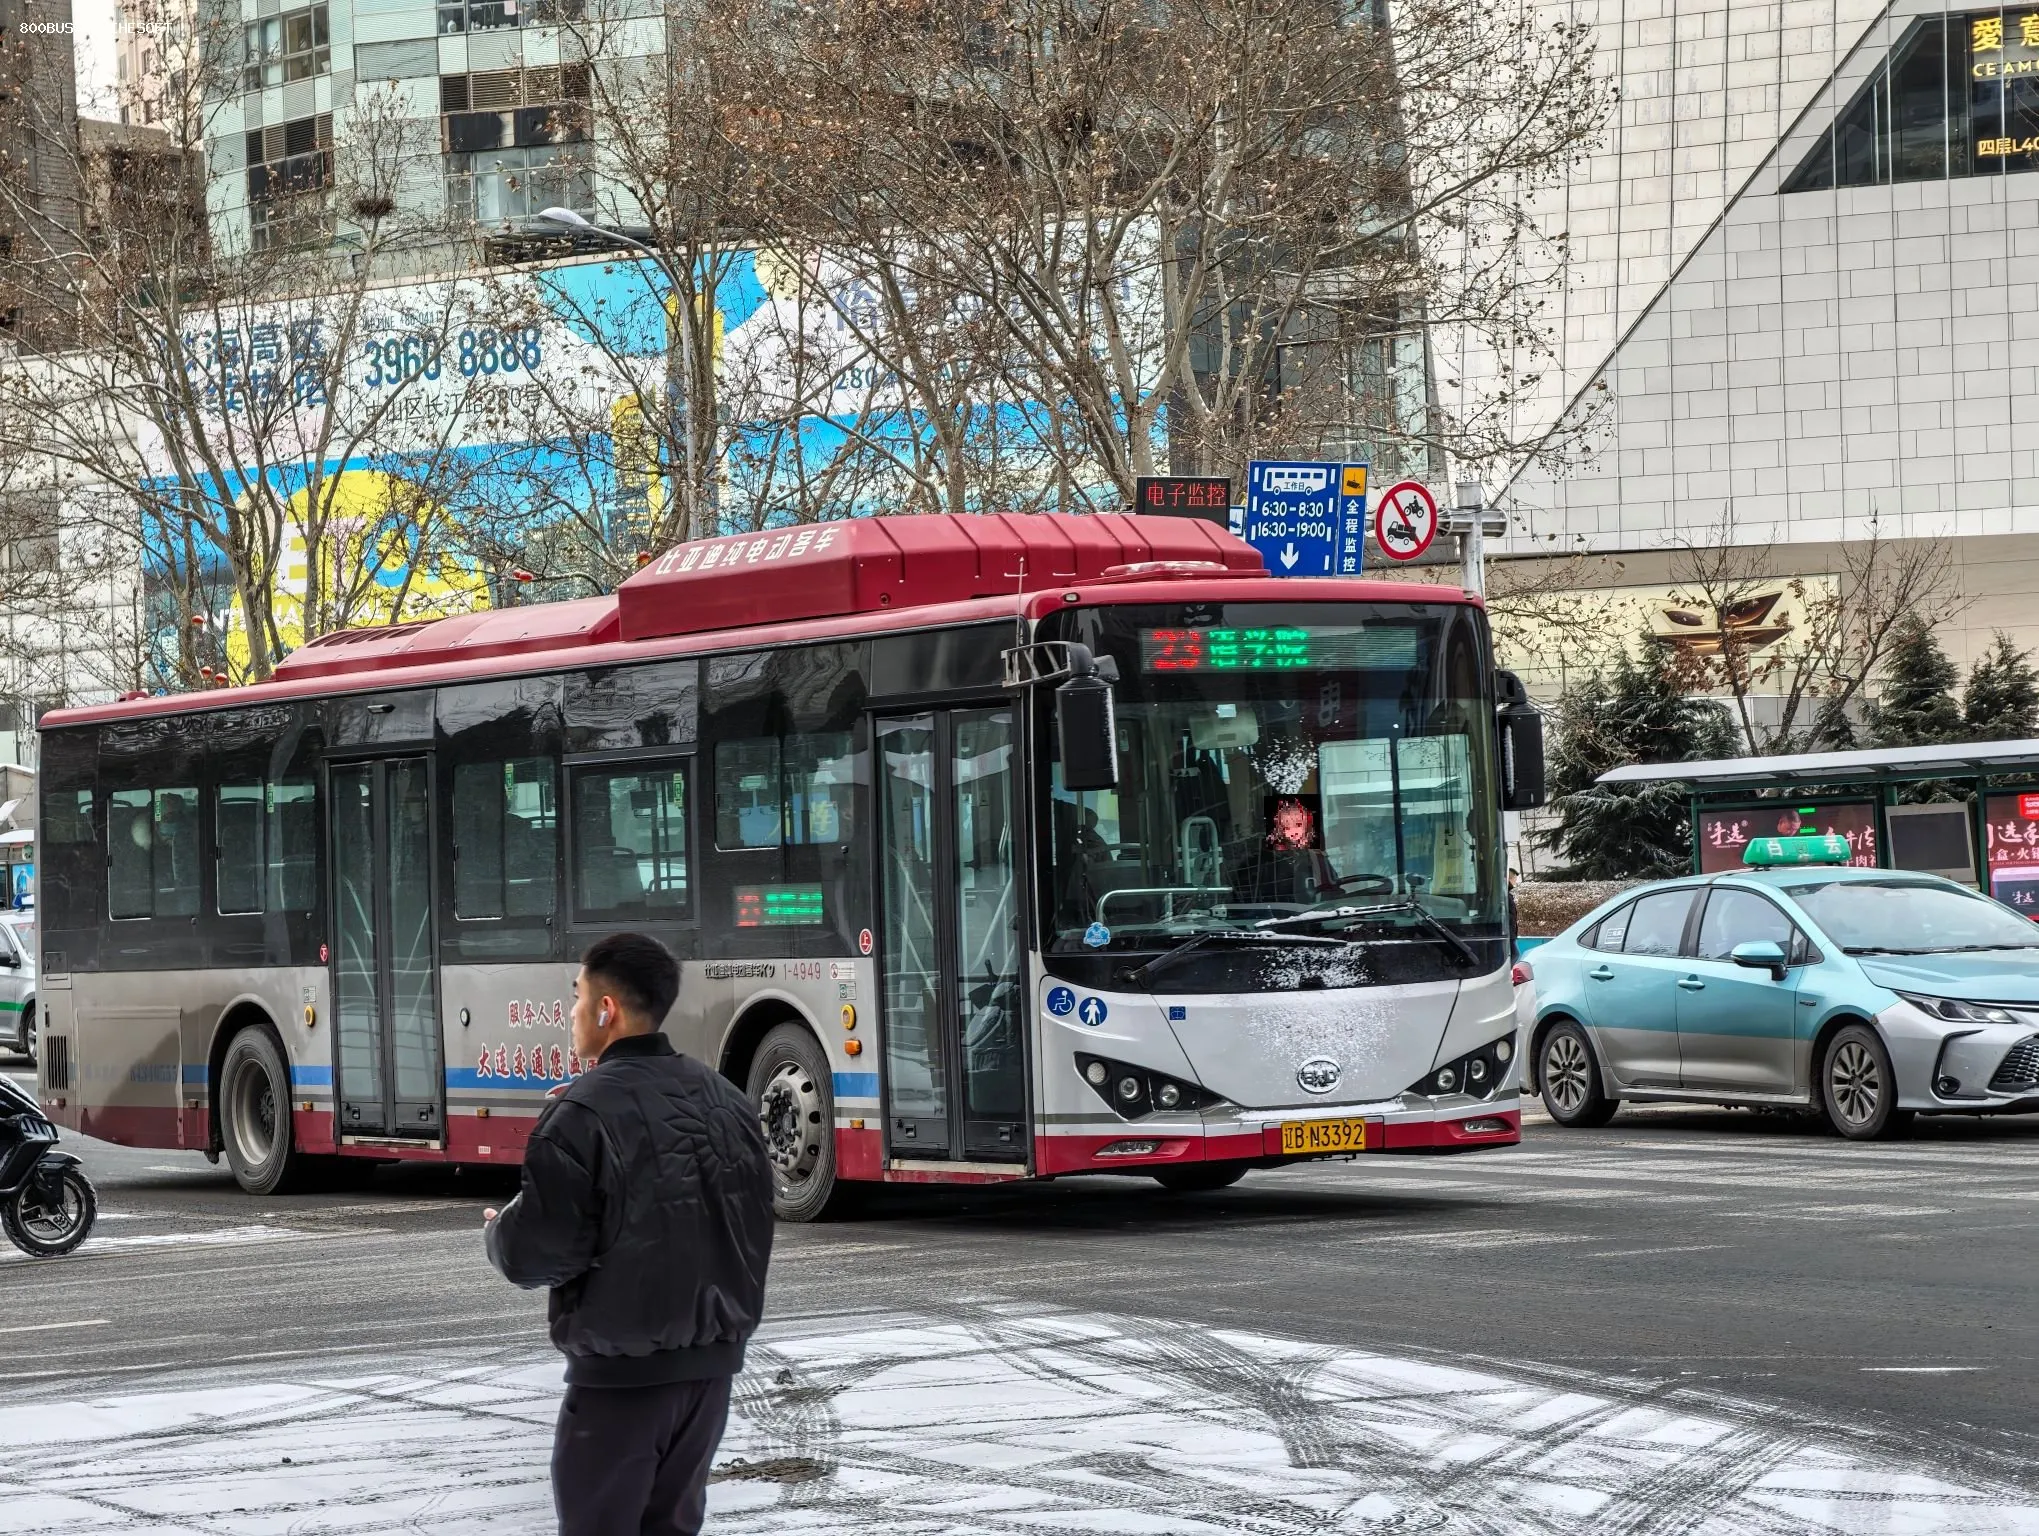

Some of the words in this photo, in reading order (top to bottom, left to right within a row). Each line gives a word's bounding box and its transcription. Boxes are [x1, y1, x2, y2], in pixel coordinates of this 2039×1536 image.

[364, 334, 441, 387] 3960
[458, 326, 542, 377] 8888
[1147, 482, 1227, 507] 电子监控
[1283, 481, 1305, 491] 工作日
[655, 527, 841, 576] 比亚迪纯电动客车
[1343, 499, 1360, 573] 全程监控
[782, 961, 821, 981] 1-4949
[508, 1000, 566, 1031] 服务人民
